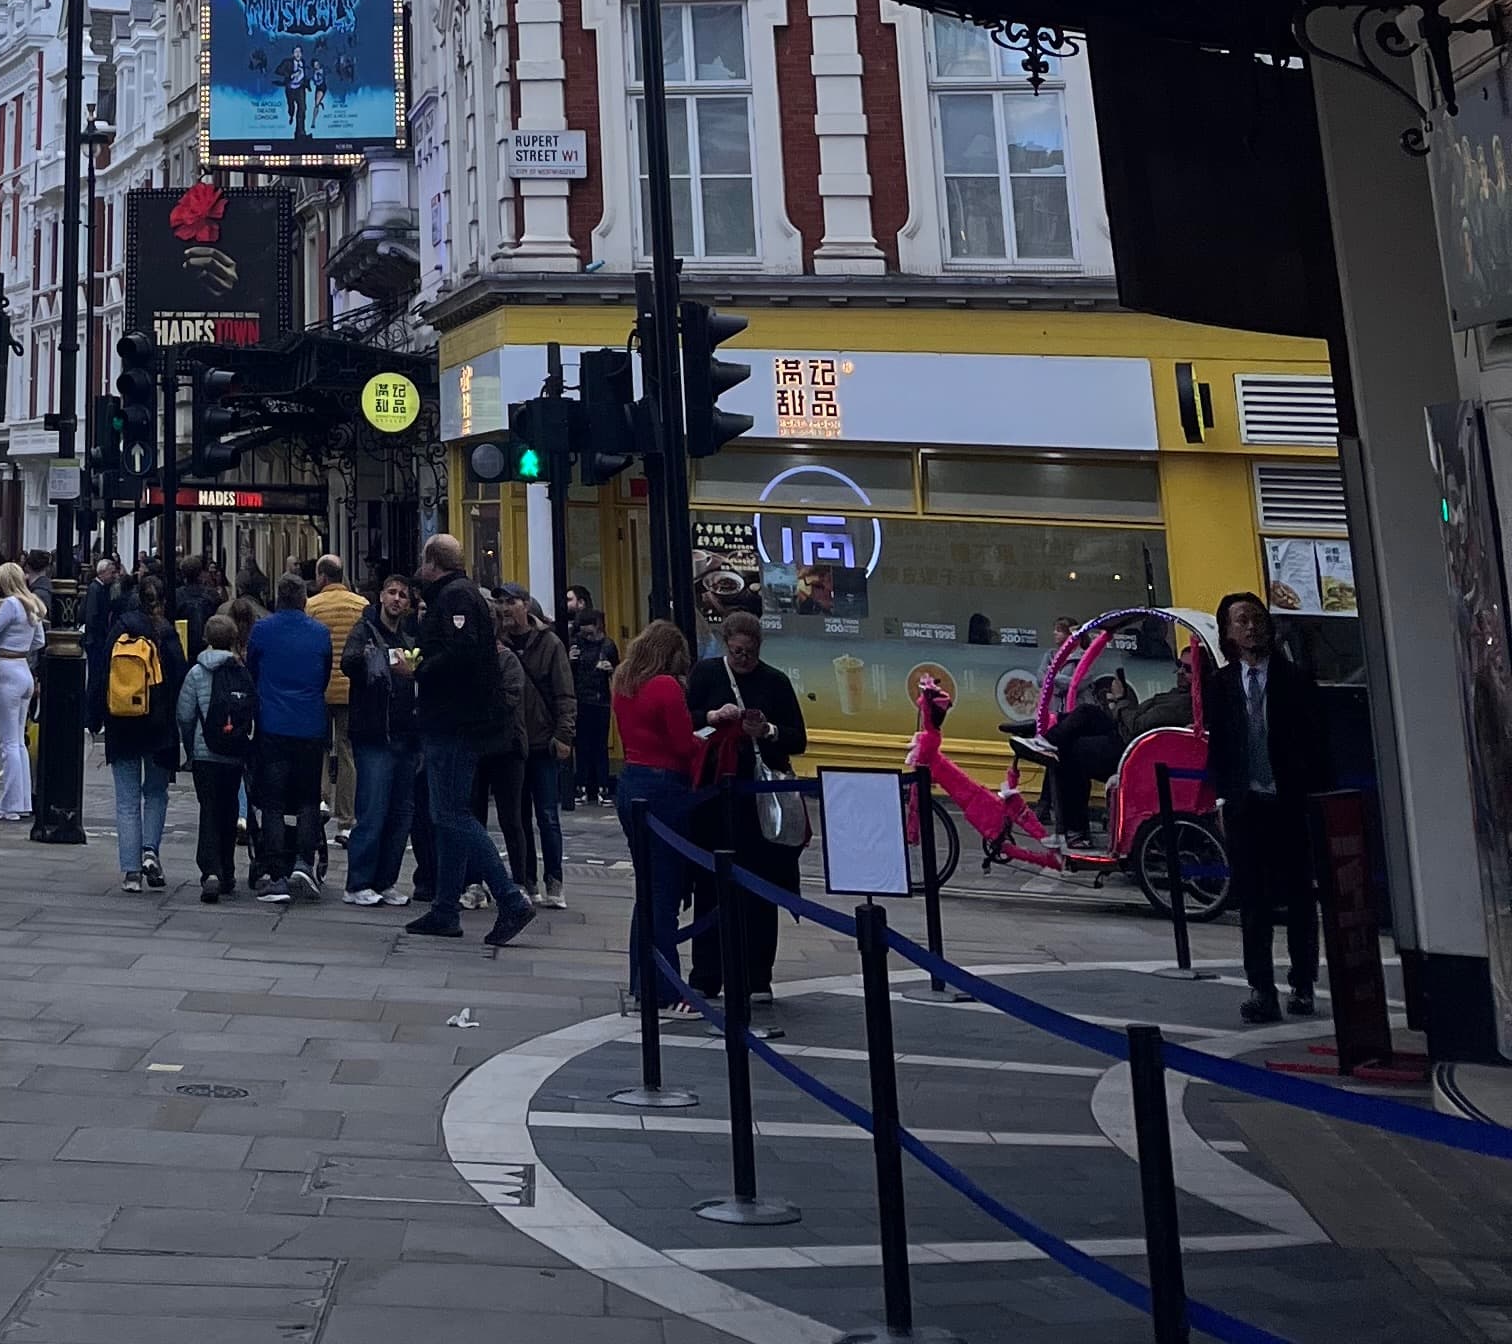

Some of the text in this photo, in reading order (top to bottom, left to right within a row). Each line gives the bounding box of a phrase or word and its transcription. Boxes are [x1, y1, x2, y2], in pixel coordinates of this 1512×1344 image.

[515, 135, 559, 147] RUPERT
[515, 150, 579, 162] STREET W1
[903, 628, 956, 640] SINCE 1995
